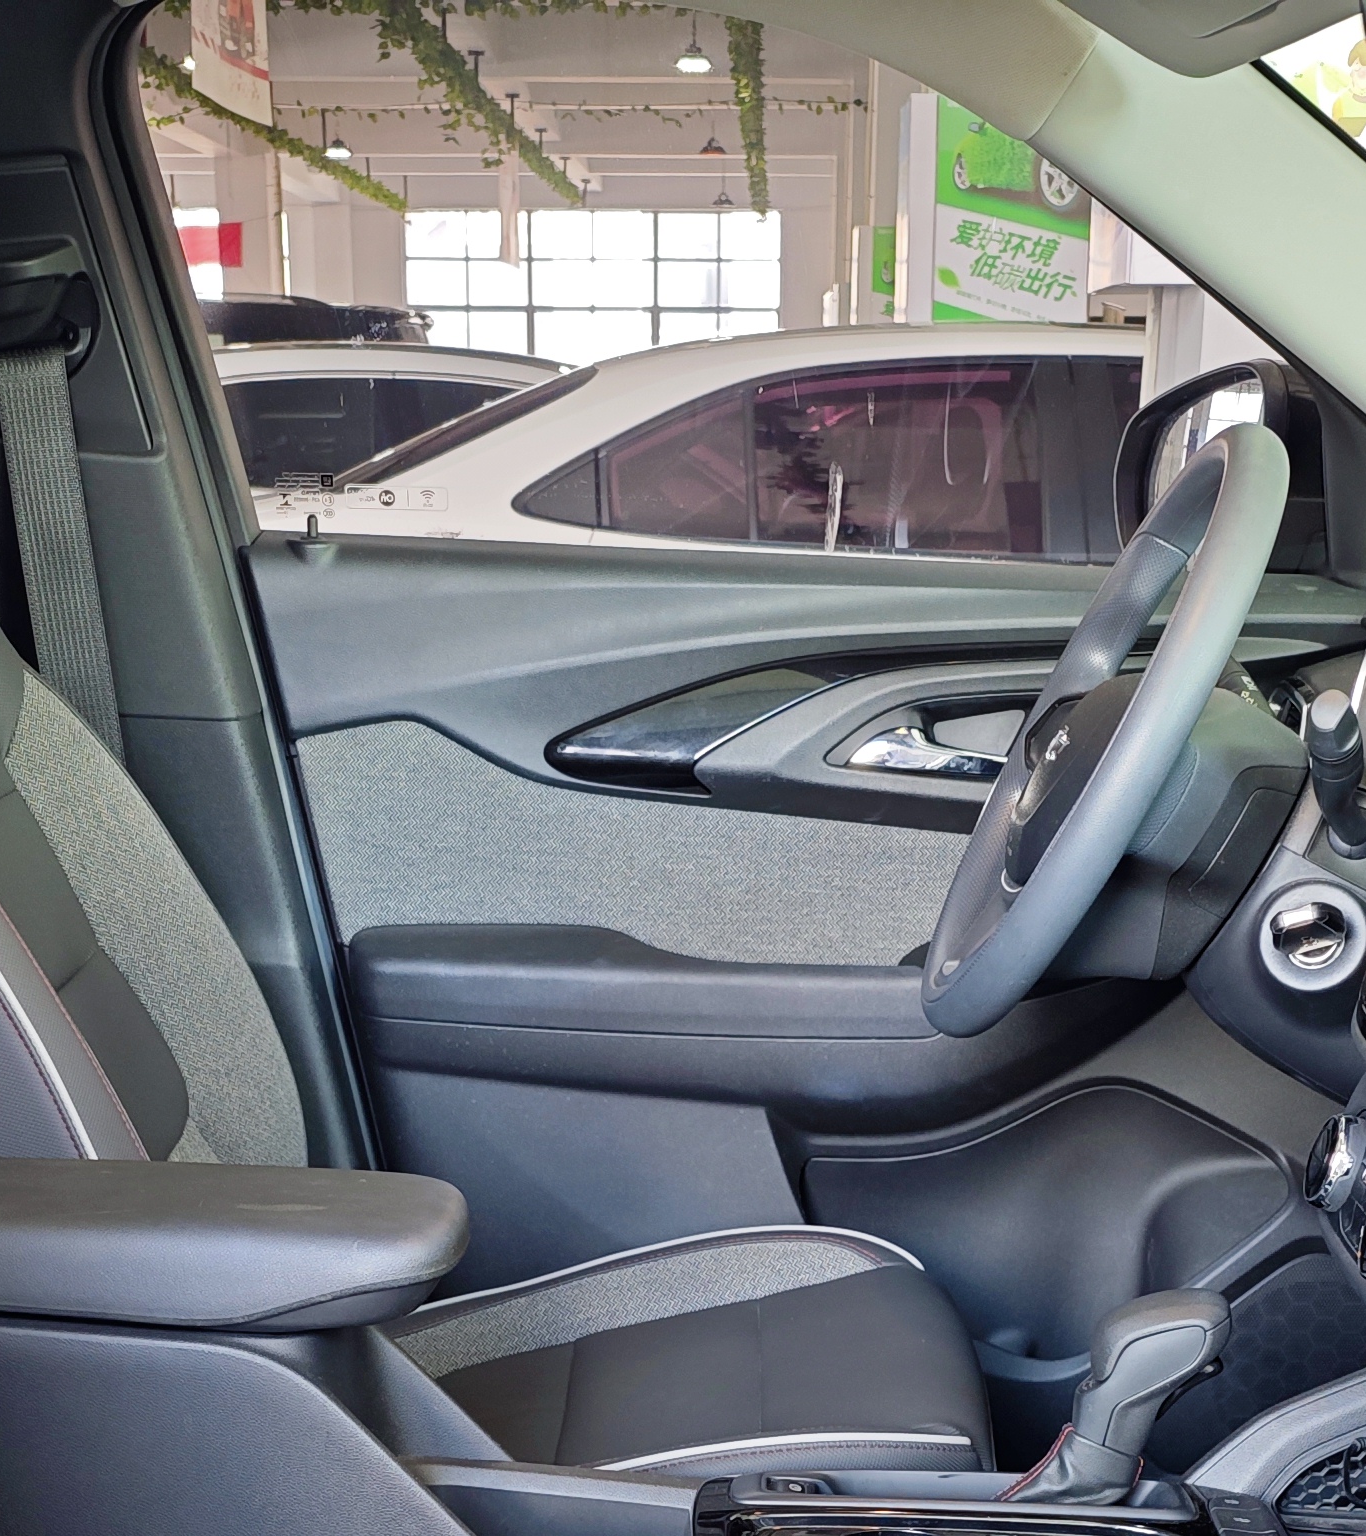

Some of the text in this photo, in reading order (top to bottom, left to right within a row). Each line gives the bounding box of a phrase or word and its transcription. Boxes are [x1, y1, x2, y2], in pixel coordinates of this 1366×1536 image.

[949, 219, 1061, 267] 爱护环境
[969, 252, 1077, 302] 低碳出行
